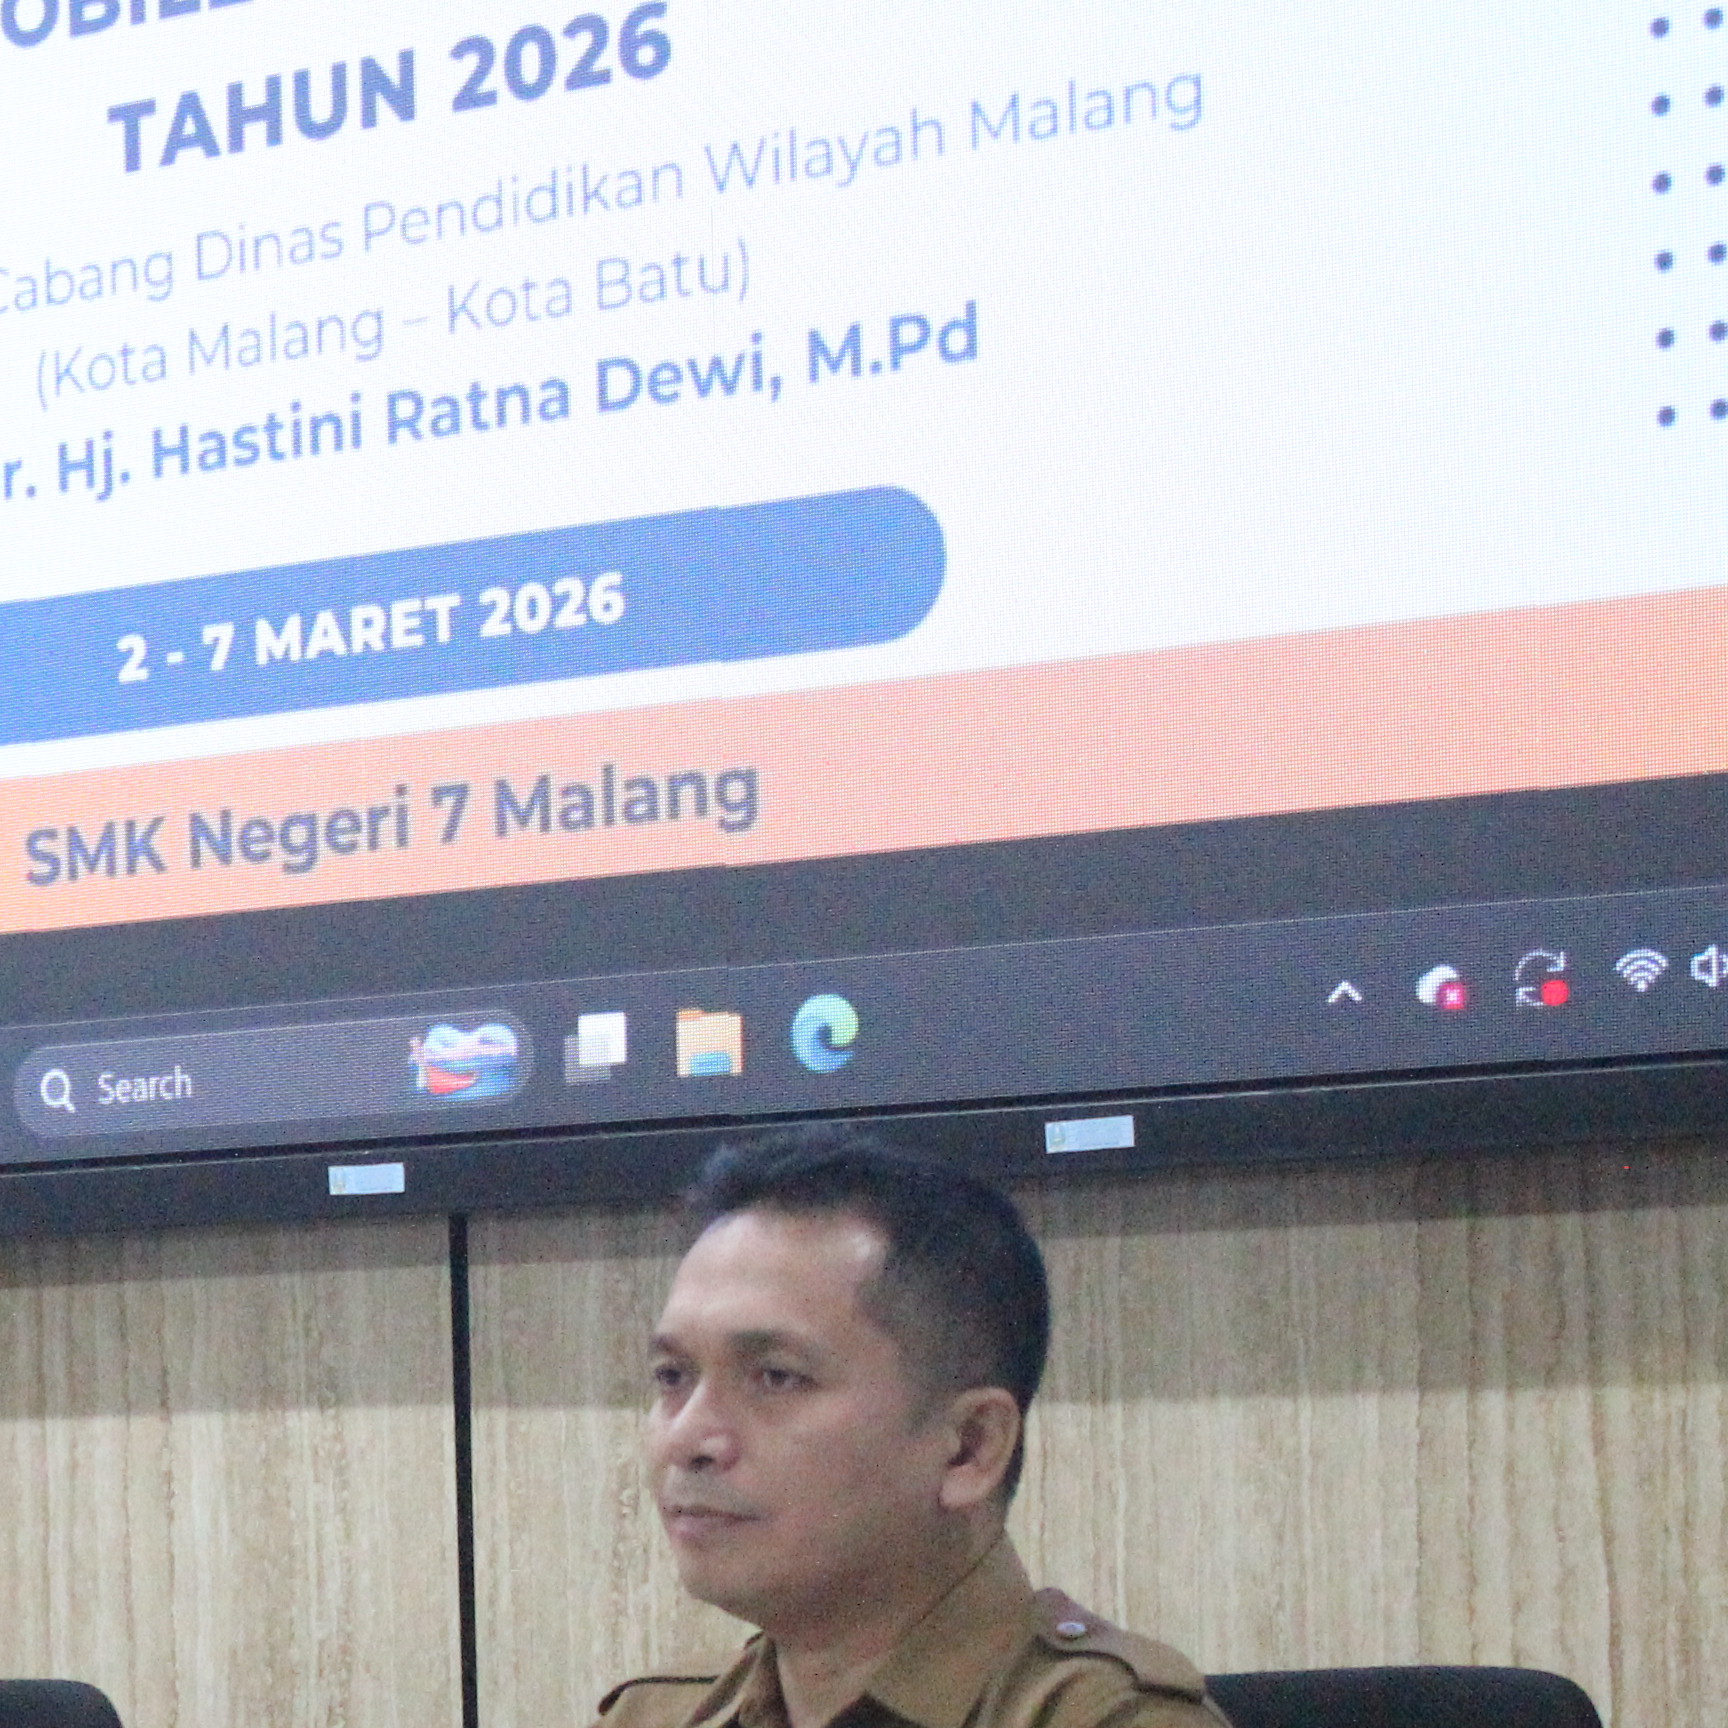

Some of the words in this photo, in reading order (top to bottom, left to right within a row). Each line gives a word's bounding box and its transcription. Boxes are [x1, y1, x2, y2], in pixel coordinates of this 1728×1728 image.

[106, 46, 416, 174] TAHUN
[449, 1, 672, 114] 2026
[194, 222, 344, 282] Dinas
[362, 162, 683, 253] Pendidikan
[704, 106, 945, 194] Wilayah
[969, 72, 1203, 152] Malang
[36, 341, 168, 412] (Kota
[187, 307, 385, 375] Malang
[446, 273, 573, 335] Kota
[596, 236, 749, 312] Batu)
[56, 428, 131, 502] Hj.
[151, 390, 363, 479] Hastini
[385, 374, 571, 446] Ratna
[595, 329, 783, 414] Dewi,
[806, 298, 979, 385] M.Pd
[116, 633, 150, 686] 2
[201, 621, 235, 673] 7
[253, 593, 462, 668] MARET
[478, 570, 626, 639] 2026
[25, 815, 169, 888] SMK
[187, 783, 411, 876] Negeri
[429, 781, 471, 845] 7
[492, 763, 761, 834] Malang
[97, 1064, 193, 1105] Search
